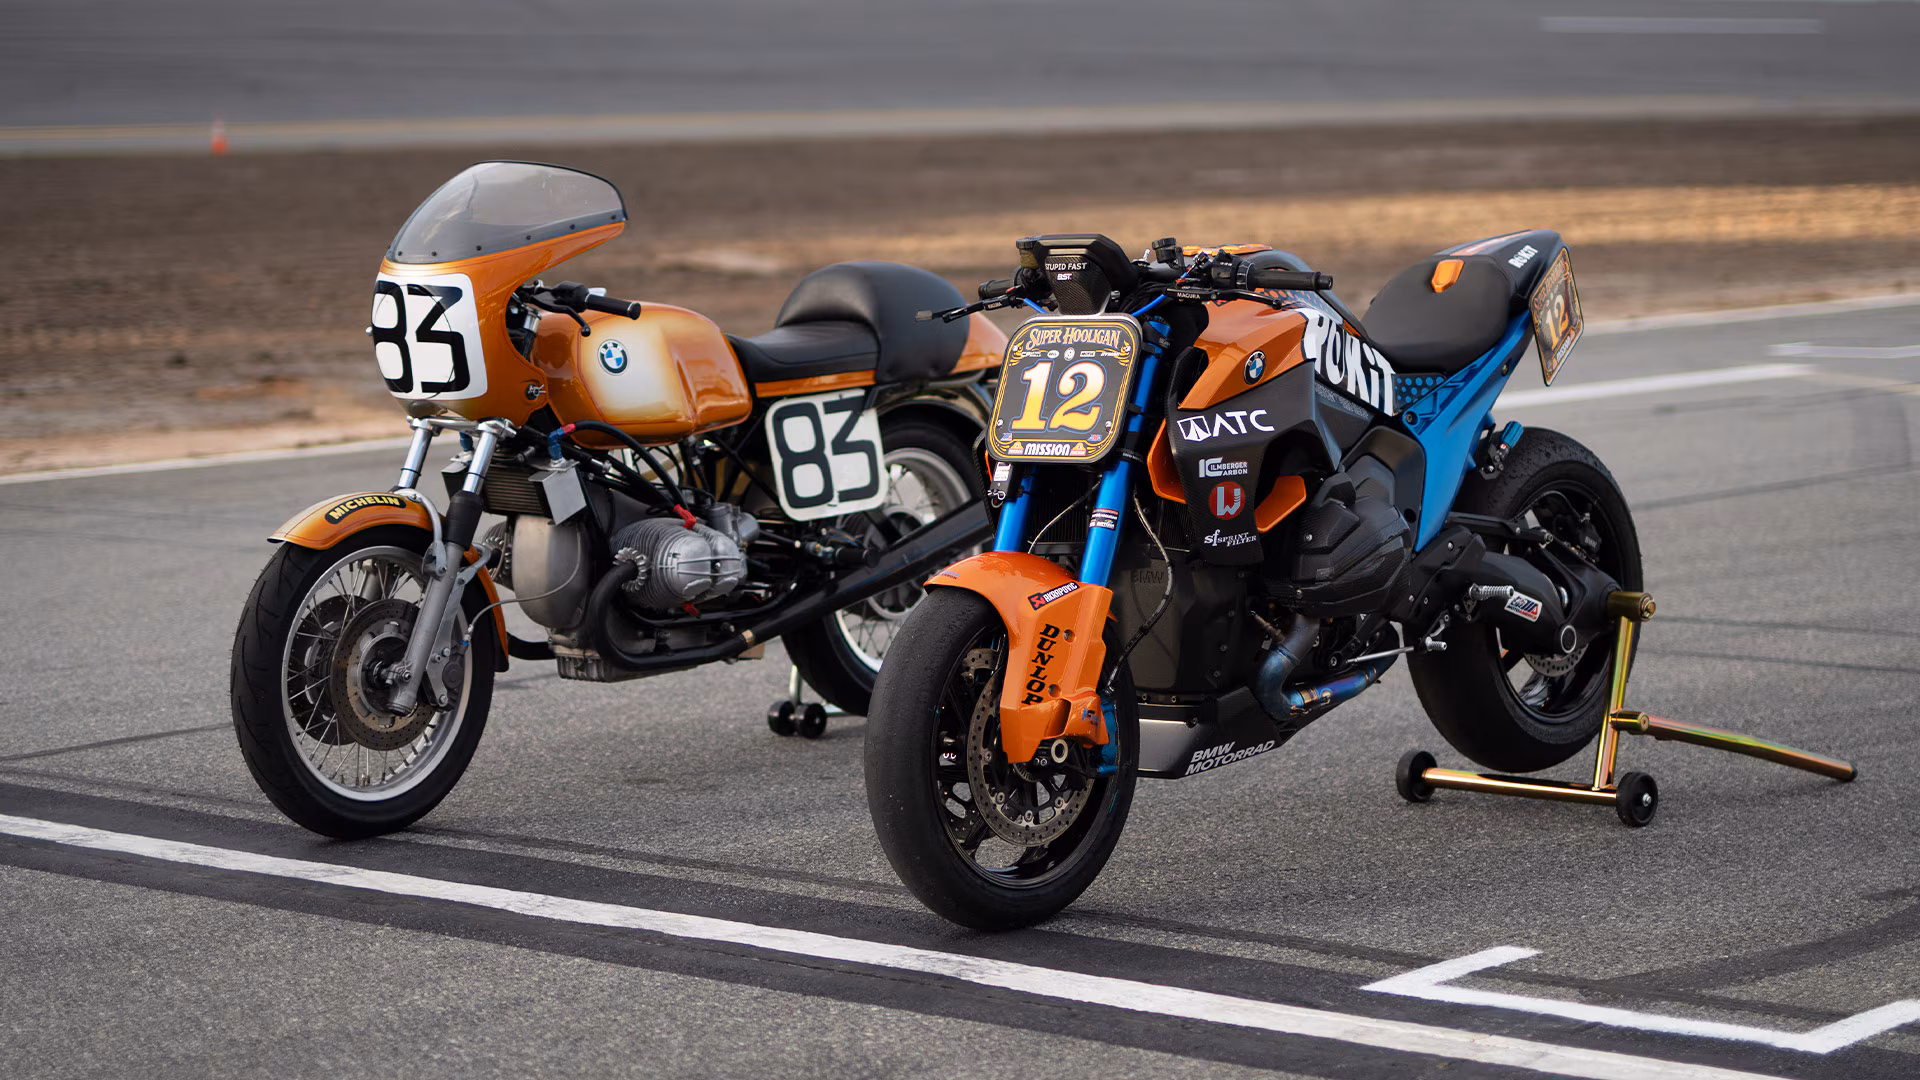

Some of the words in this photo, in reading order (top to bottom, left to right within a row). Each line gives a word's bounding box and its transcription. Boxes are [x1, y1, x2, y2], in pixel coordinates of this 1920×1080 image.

[1056, 273, 1072, 281] BST
[1067, 262, 1088, 270] FAST
[1176, 292, 1201, 300] MAGURA
[1545, 294, 1569, 351] 12
[371, 280, 471, 394] 83
[1062, 326, 1121, 350] HOOLIGAN
[1009, 359, 1107, 433] 12
[1212, 409, 1275, 437] ATC
[772, 395, 880, 509] 83
[1210, 462, 1248, 471] ILMBERGER
[329, 496, 400, 520] MICHELIN
[1217, 532, 1249, 543] SPRINT
[1226, 535, 1257, 547] FILTER
[1021, 623, 1060, 705] DUNLOP
[1184, 740, 1275, 776] MOTORRAD
[1191, 741, 1236, 763] BMW
